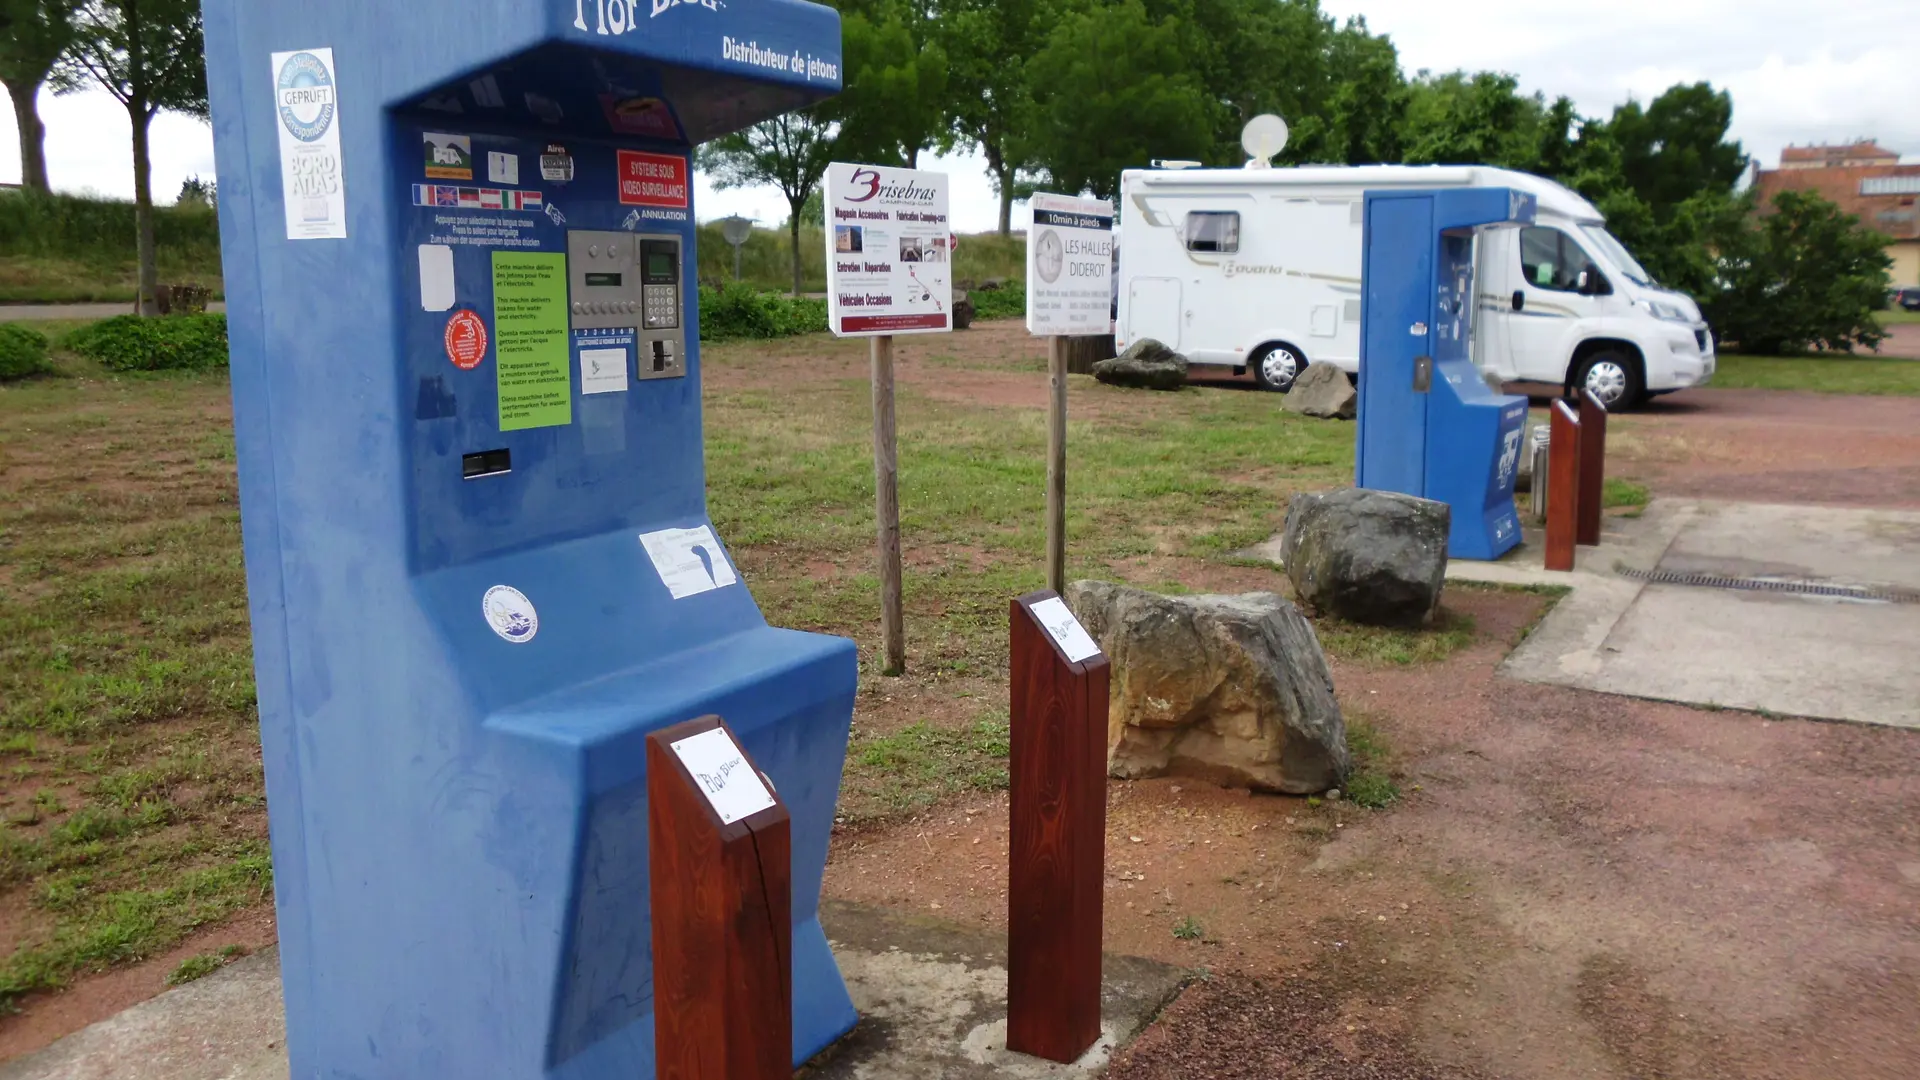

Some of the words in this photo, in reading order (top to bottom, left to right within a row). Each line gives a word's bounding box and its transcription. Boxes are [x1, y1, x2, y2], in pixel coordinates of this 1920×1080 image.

[723, 36, 788, 70] Distributeur
[792, 50, 804, 73] de
[807, 54, 837, 81] jetons
[285, 88, 328, 105] GEPRÜFT
[630, 161, 658, 177] SYSTEME
[659, 164, 674, 179] SOUS
[622, 180, 641, 195] VIDEO
[642, 181, 684, 199] SURVEILLANCE
[642, 210, 687, 220] ANNULATION
[834, 207, 857, 221] Magasin
[858, 208, 889, 220] Accessoires
[1049, 214, 1072, 224] 10min
[1074, 216, 1078, 225] à
[1080, 218, 1100, 228] pieds
[1065, 240, 1080, 254] LES
[1082, 240, 1111, 256] HALLES
[837, 262, 860, 272] Entretien
[864, 261, 891, 274] Réparation
[1070, 262, 1106, 277] DIDEROT
[506, 272, 524, 280] jetons
[838, 293, 864, 306] Véhicules
[866, 293, 892, 306] Occasions
[499, 338, 518, 346] gettoni
[510, 362, 534, 370] apparaat
